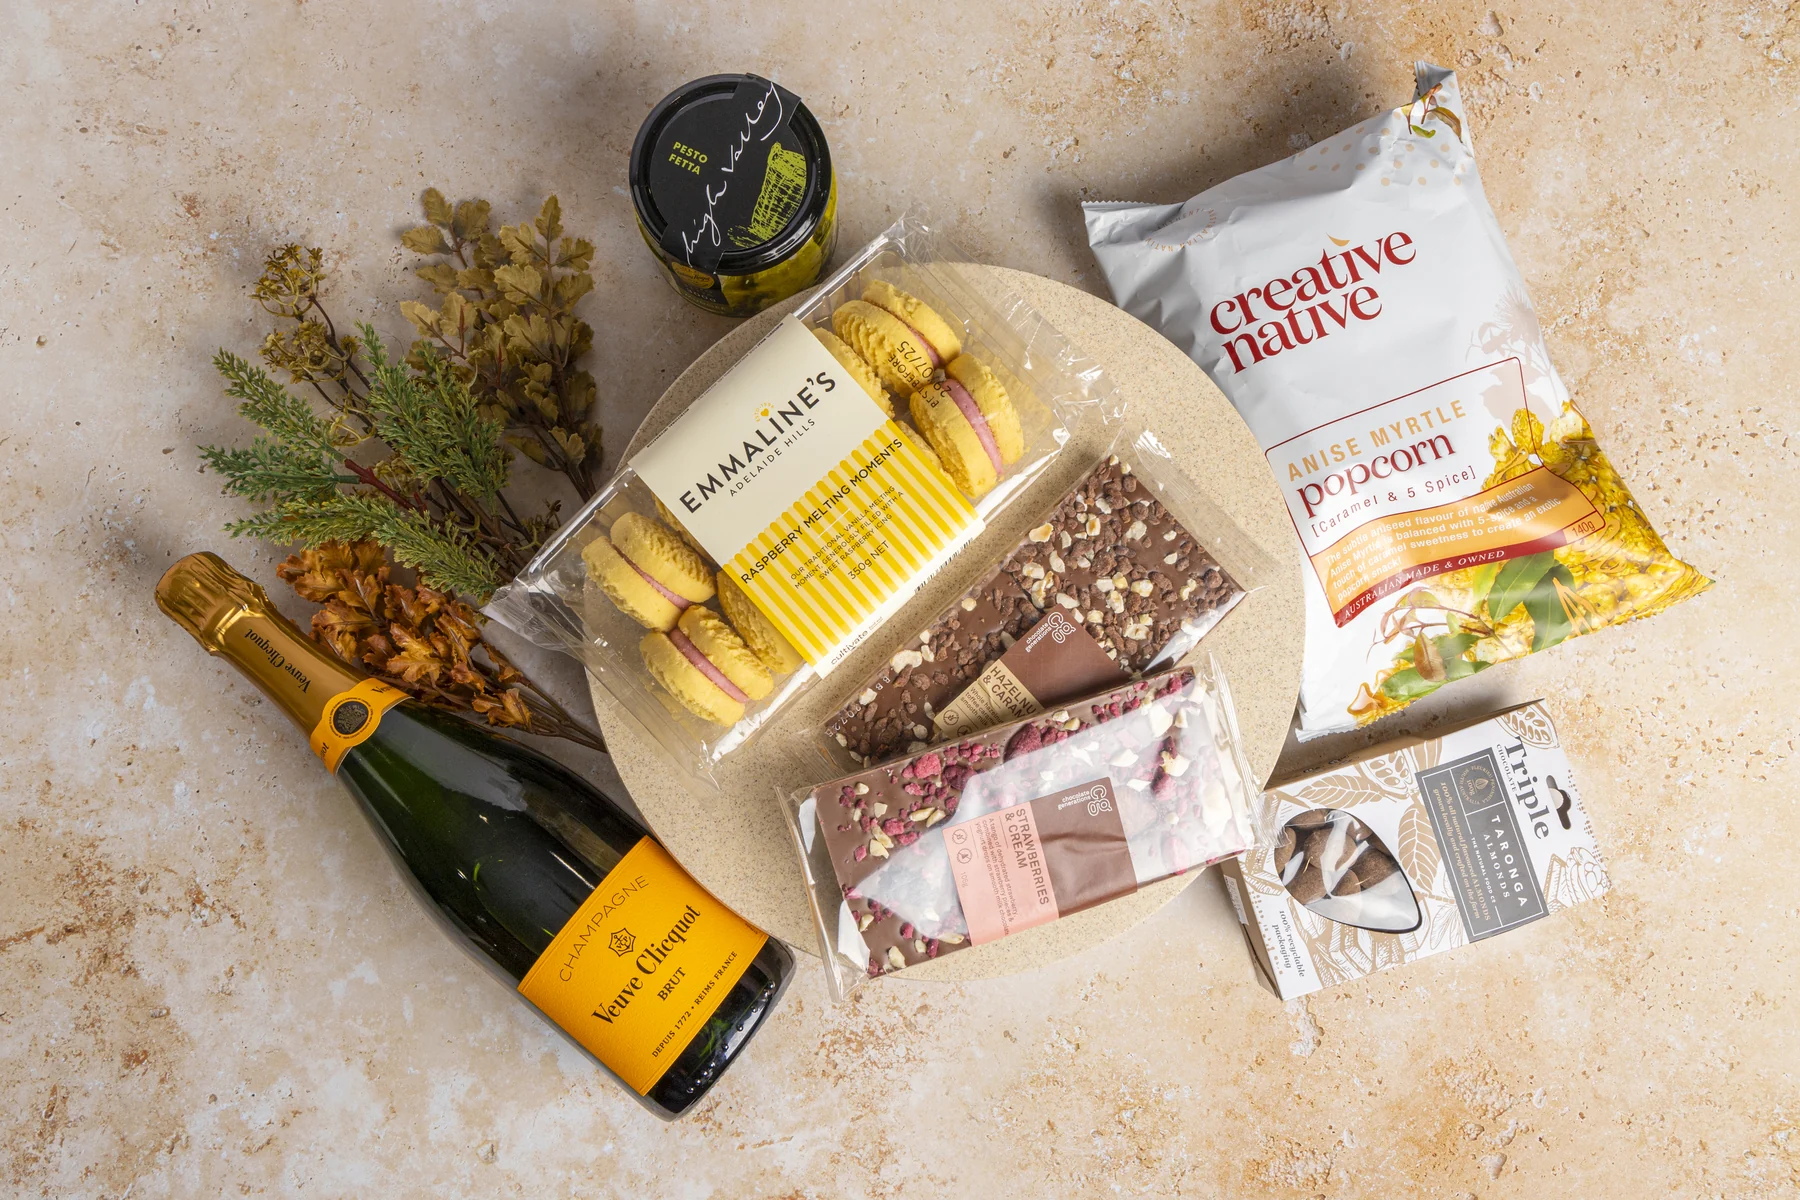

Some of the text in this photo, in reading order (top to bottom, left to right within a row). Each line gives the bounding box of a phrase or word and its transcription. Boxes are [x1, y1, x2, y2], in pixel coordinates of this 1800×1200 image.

[668, 153, 701, 175] FETTA
[672, 141, 708, 164] PESTO
[1210, 231, 1416, 335] creative
[1221, 286, 1382, 374] native
[888, 353, 940, 408] BEST BEFORE
[727, 417, 816, 496] ADELAIDE HILLS
[1288, 399, 1466, 482] ANISE MYRTLE
[1297, 434, 1456, 519] popcorn
[1388, 491, 1398, 501] &
[1407, 488, 1416, 498] 5
[740, 436, 903, 584] RASPBERRY MELTING MOMENTS
[789, 484, 895, 580] OUR TRADITIONAL VANILLA MELTING
[794, 489, 904, 589] MOMENT, GENEROUSLY FILLED WITH A
[1324, 482, 1535, 567] The subtle aniseed flavour of native Australian
[1329, 558, 1352, 579] Anise
[1396, 524, 1447, 541] balanced
[1450, 518, 1474, 531] with
[1515, 499, 1530, 513] and
[1531, 496, 1538, 504] a
[1332, 495, 1562, 590] touch of caramel sweetness to create an exotic
[1571, 519, 1596, 538] 140g
[818, 512, 892, 580] SWEET RASPBERRY ICING
[847, 539, 890, 580] 350g NET
[1336, 572, 1370, 604] popcorn
[1344, 550, 1505, 620] AUSTRALIAN MADE & OWNED
[244, 628, 312, 694] Veuve Clicquot
[828, 628, 869, 666] cultivate
[1024, 626, 1052, 653] generations
[1025, 622, 1048, 644] chocolate
[959, 696, 978, 716] smooth
[964, 691, 995, 725] toffee carame
[969, 686, 986, 704] Whole
[982, 673, 993, 685] &
[989, 665, 1037, 716] HAZELNU
[1062, 789, 1090, 803] chocolate
[1496, 743, 1517, 794] CHOCOLATE
[1504, 736, 1550, 840] Triple
[974, 822, 986, 845] yoghurt
[980, 845, 991, 863] drops
[986, 863, 992, 871] on
[989, 871, 999, 894] smooth
[995, 895, 1003, 908] milk
[981, 819, 994, 849] combined
[993, 864, 1006, 895] strawberry
[1001, 897, 1011, 915] pieces
[988, 823, 998, 840] tango
[995, 848, 1009, 882] dehydrated
[1004, 812, 1027, 868] & CREAM
[1015, 808, 1049, 905] STRAWBERRIES
[1432, 788, 1481, 919] grown locally and crafted on the farm
[1440, 781, 1490, 921] 100% all natural flavoured ALMONDS
[1475, 851, 1486, 876] NATURAL
[1483, 876, 1493, 894] FOOD
[1482, 833, 1511, 899] ALMONDS
[1490, 814, 1528, 908] TARONGA
[559, 875, 650, 982] CHAMPAGNE
[1272, 924, 1292, 969] packaging
[1279, 910, 1305, 977] 100% recyclable
[591, 904, 701, 1026] Veuve Clicquot
[656, 966, 687, 1002] BRUT
[652, 950, 738, 1058] DEPUIS 1772 REIMS FRANCE
